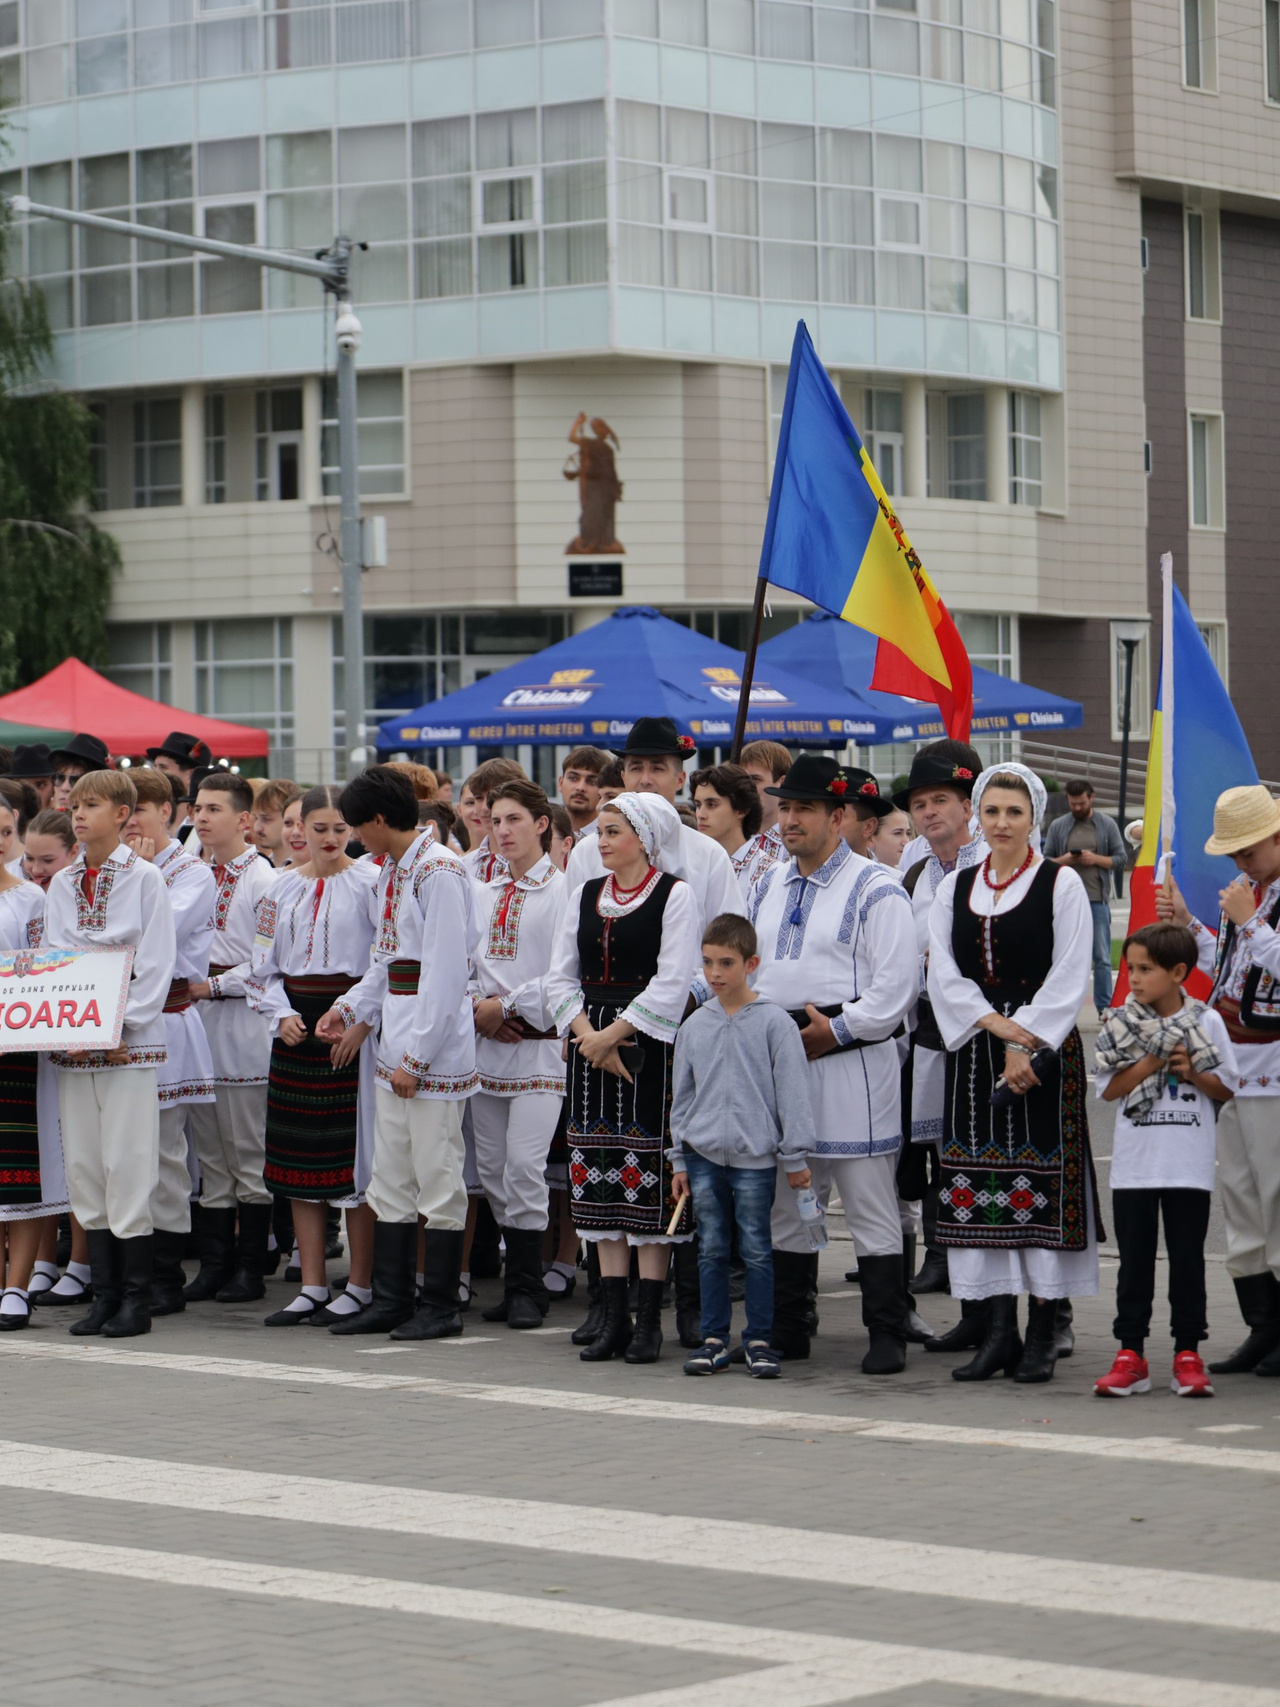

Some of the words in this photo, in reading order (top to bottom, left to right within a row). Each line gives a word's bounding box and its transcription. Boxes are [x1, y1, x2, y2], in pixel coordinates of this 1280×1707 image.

[3, 986, 15, 995] DE
[21, 985, 45, 994] DANS
[51, 983, 96, 992] POPULAR
